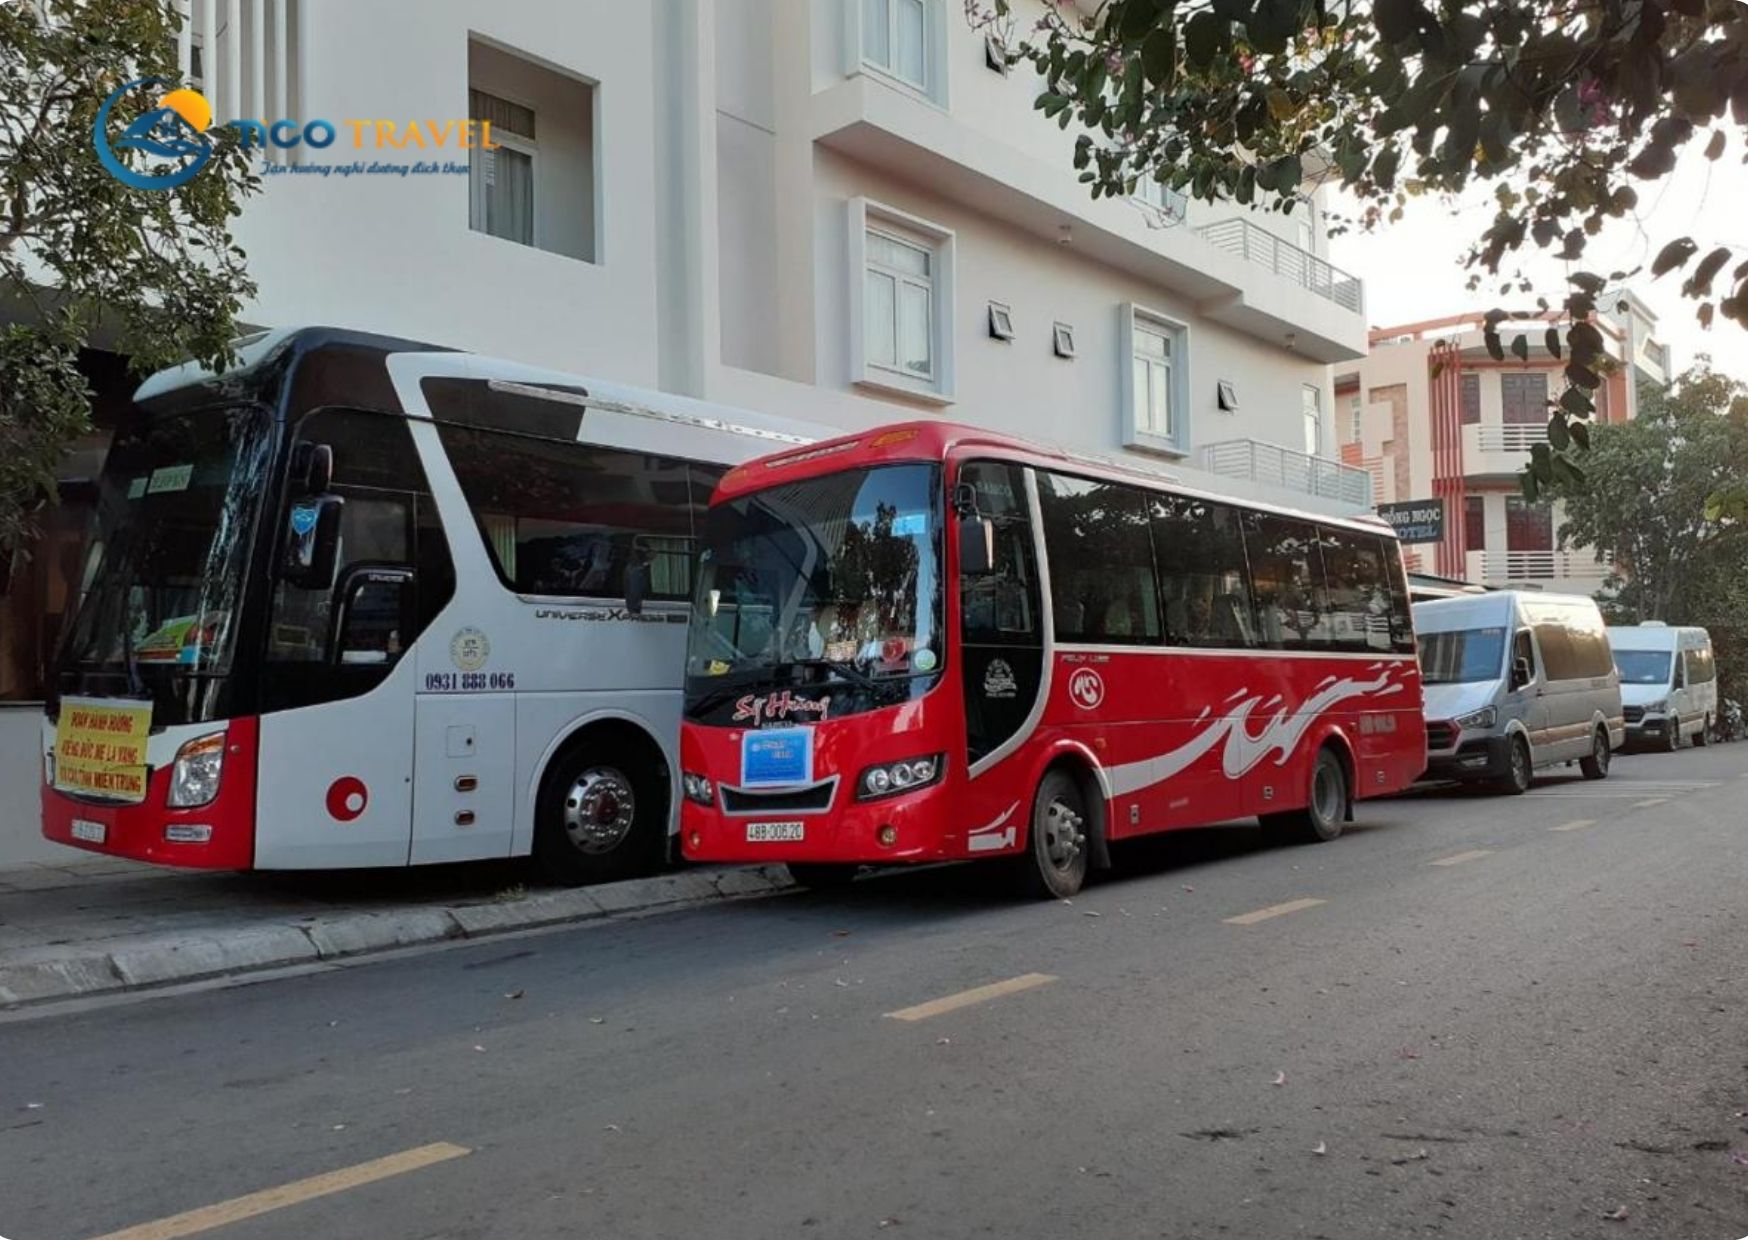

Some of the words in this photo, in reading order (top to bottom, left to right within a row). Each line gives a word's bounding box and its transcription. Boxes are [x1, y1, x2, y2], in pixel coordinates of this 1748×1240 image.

[425, 672, 458, 691] 0931
[461, 672, 487, 690] 888
[489, 672, 515, 689] 066
